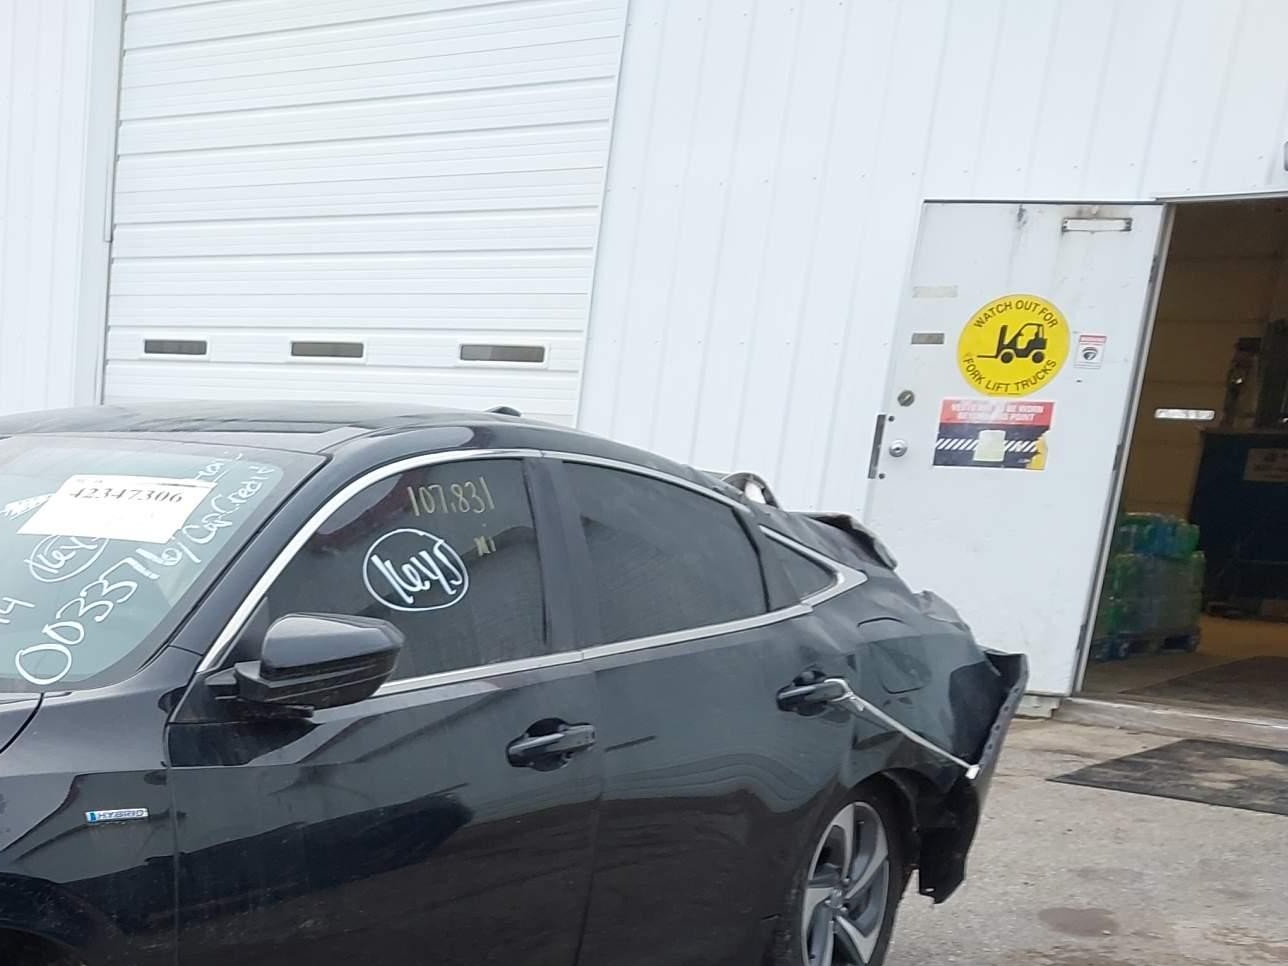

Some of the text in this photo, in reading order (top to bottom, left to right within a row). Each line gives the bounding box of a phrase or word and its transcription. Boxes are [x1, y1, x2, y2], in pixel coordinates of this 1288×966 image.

[973, 299, 1059, 328] WATCH OUT FOR
[963, 357, 1057, 393] FORK LIFT TRUCKS
[69, 486, 184, 504] 42347306
